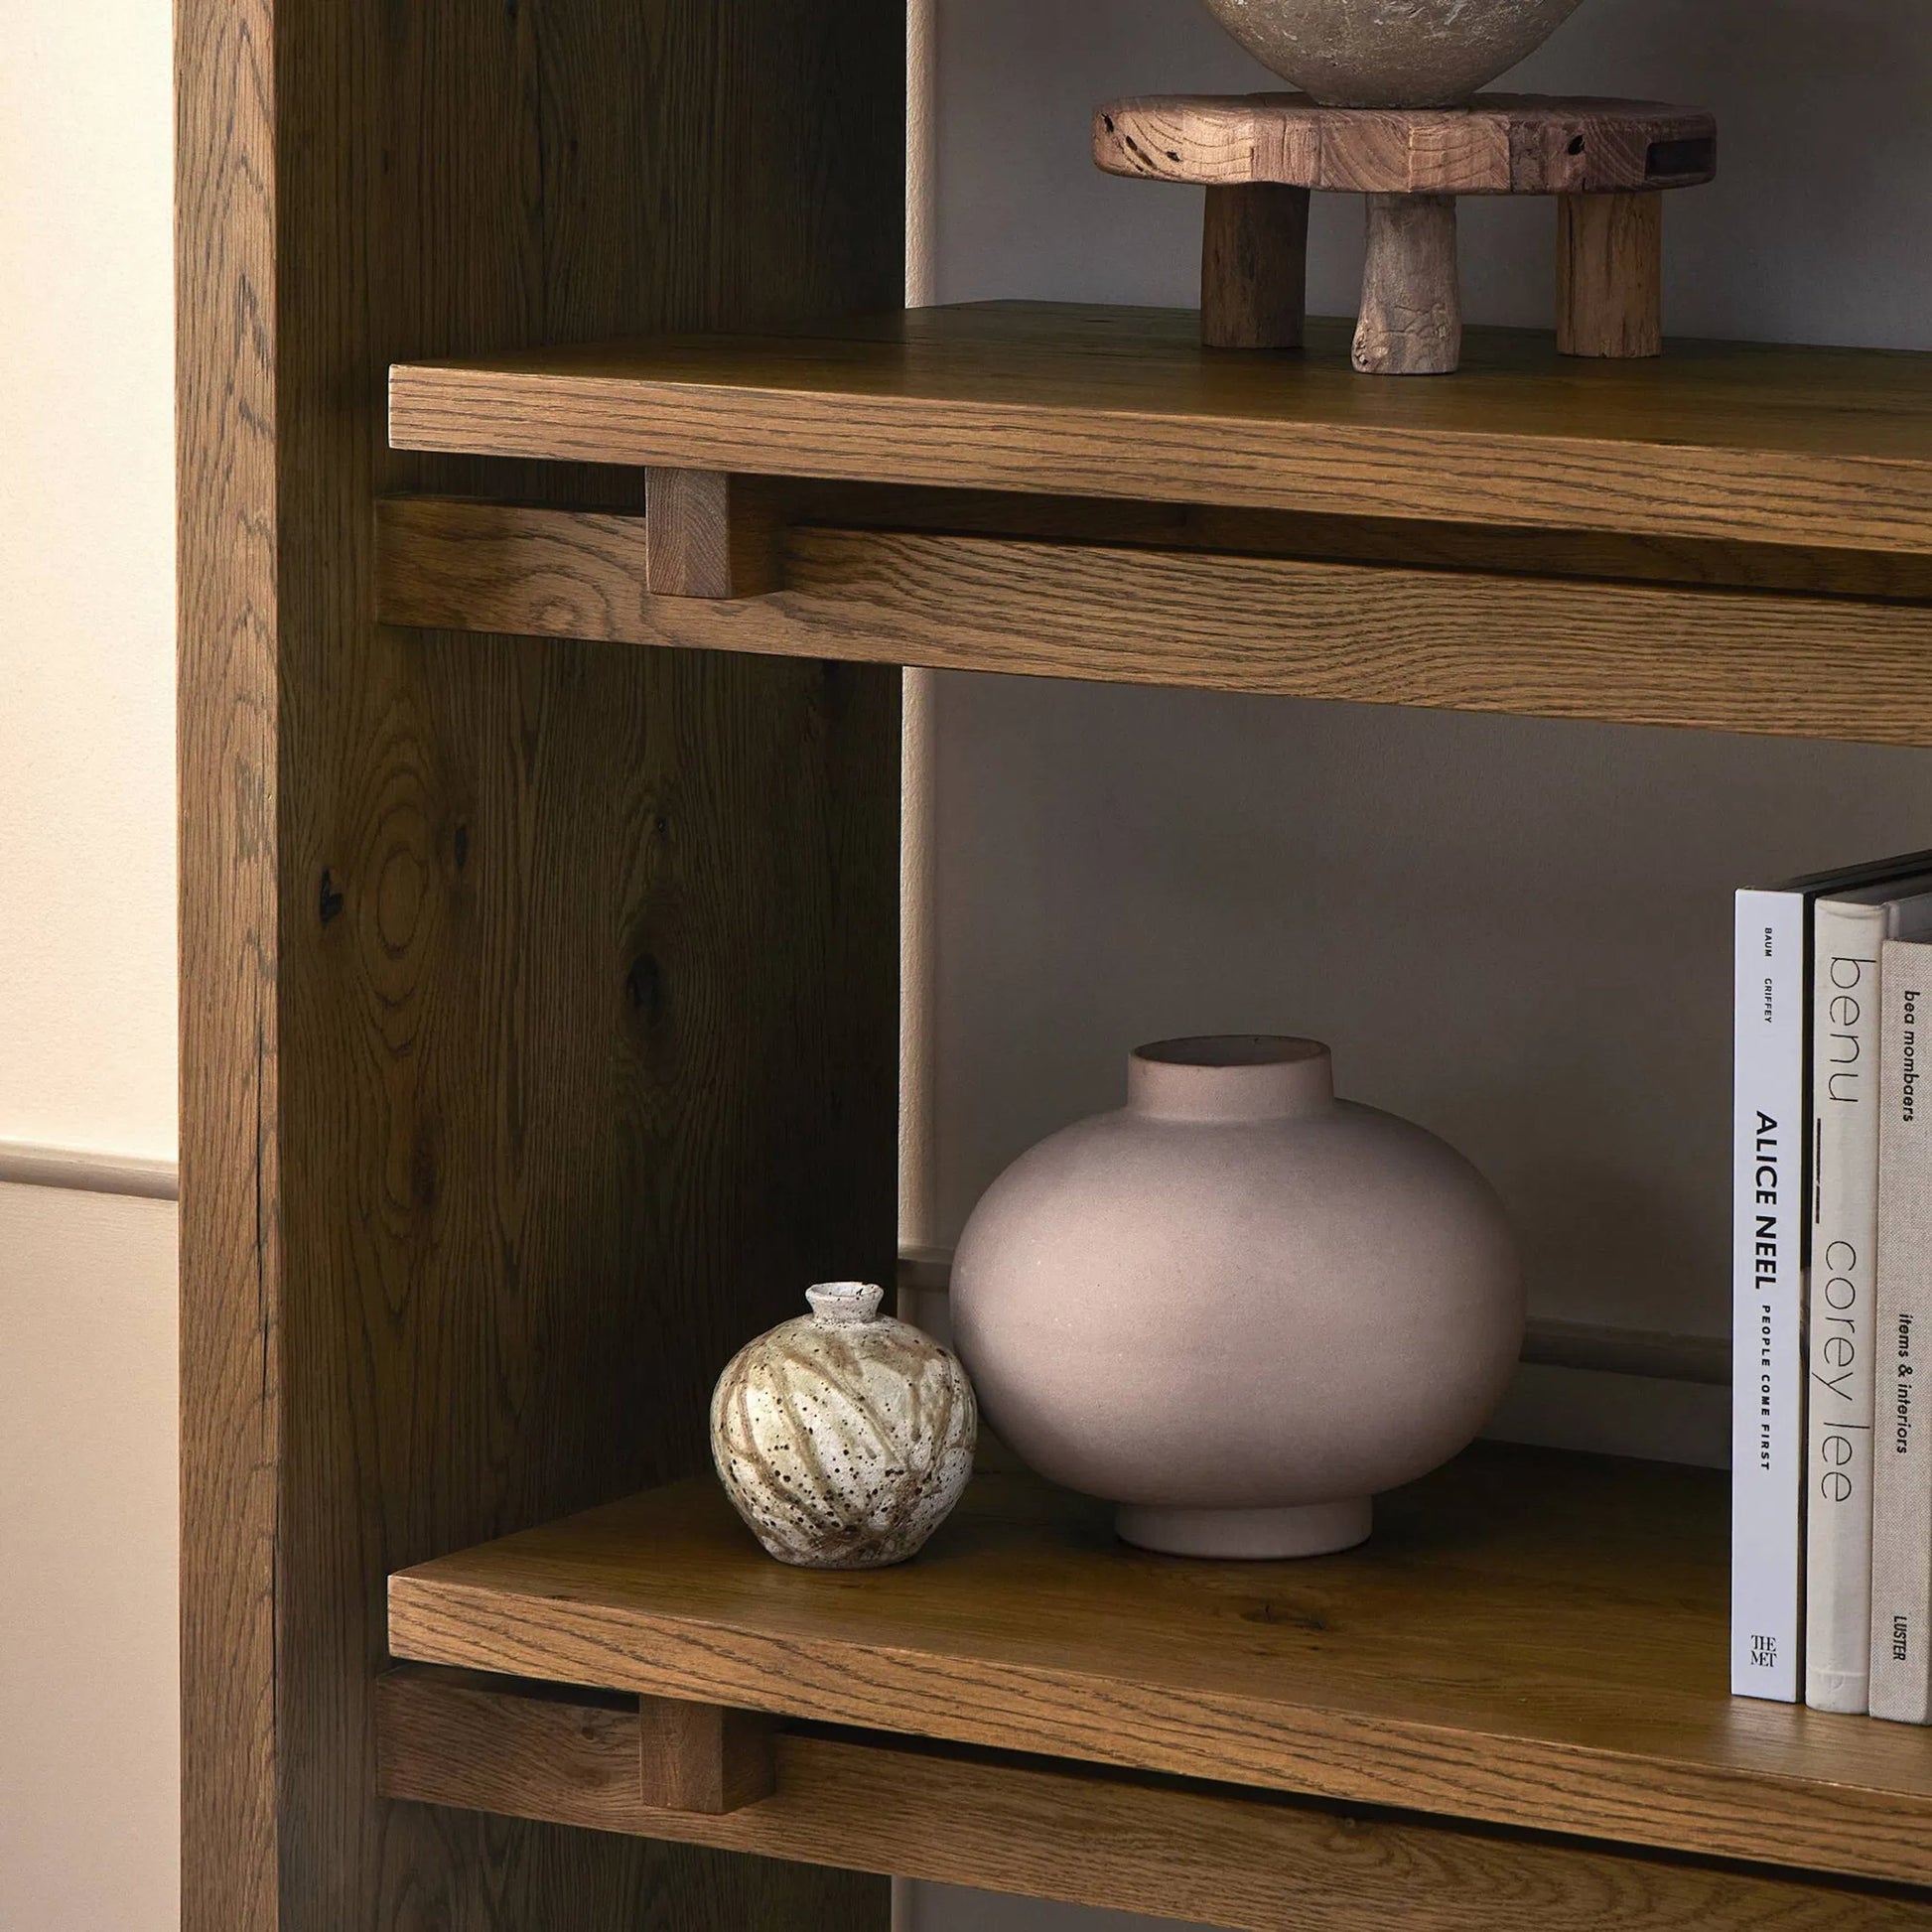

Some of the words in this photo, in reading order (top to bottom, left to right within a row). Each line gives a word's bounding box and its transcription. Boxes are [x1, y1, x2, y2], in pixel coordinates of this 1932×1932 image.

[1828, 956, 1877, 1103] benu
[1903, 990, 1921, 1025] bea
[1902, 1031, 1920, 1123] mombaers
[1754, 1110, 1778, 1205] ALICE
[1754, 1215, 1777, 1290] NEEL
[1761, 1305, 1771, 1367] PEOPLE
[1811, 1240, 1857, 1401] corey
[1898, 1313, 1914, 1358] items
[1760, 1374, 1771, 1417] COME
[1897, 1363, 1913, 1377] &
[1896, 1383, 1912, 1454] interiors
[1760, 1424, 1770, 1470] FIRST
[1821, 1422, 1870, 1502] lee
[1750, 1634, 1777, 1652] THE
[1750, 1650, 1777, 1668] MET
[1892, 1615, 1907, 1662] LUSTER
